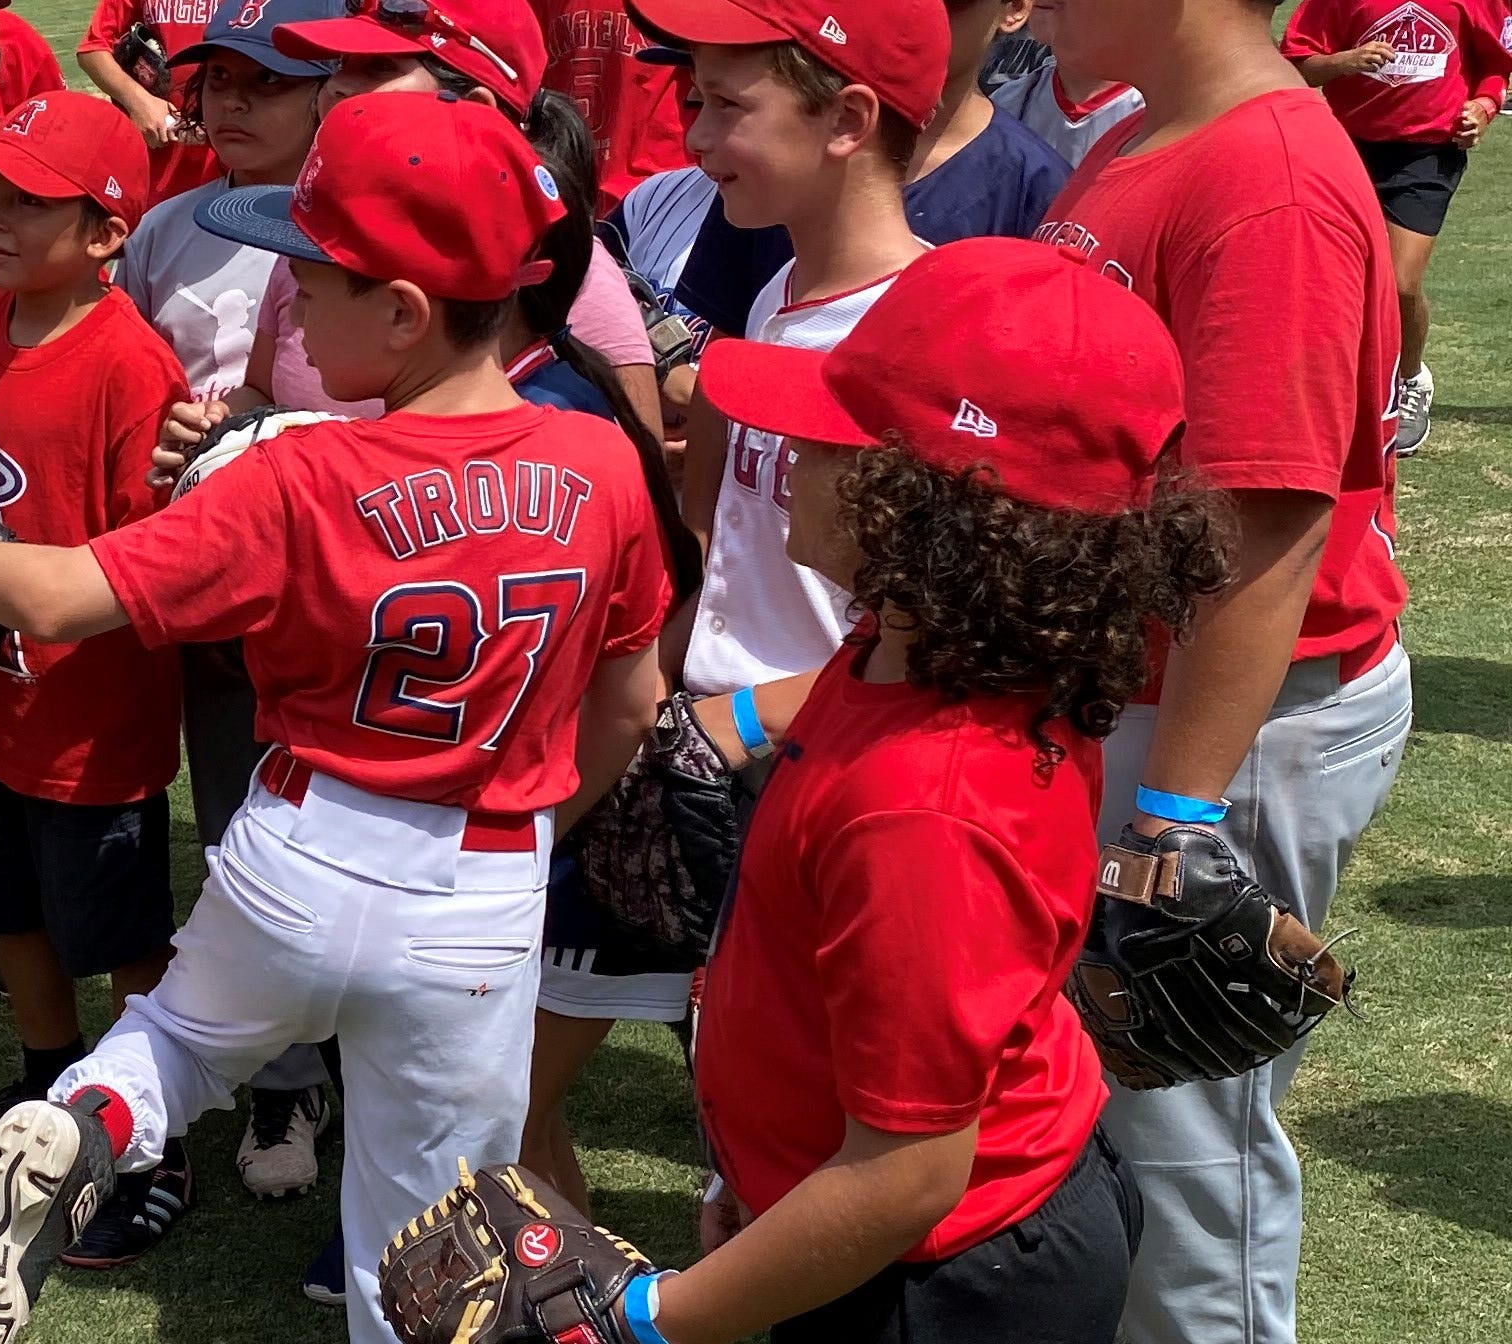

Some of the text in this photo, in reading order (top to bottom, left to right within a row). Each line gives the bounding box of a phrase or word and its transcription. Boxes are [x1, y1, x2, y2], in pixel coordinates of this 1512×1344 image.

[1399, 54, 1437, 67] ANGELS
[1419, 33, 1436, 50] 21
[357, 459, 592, 560] TROUT
[352, 567, 586, 751] 27
